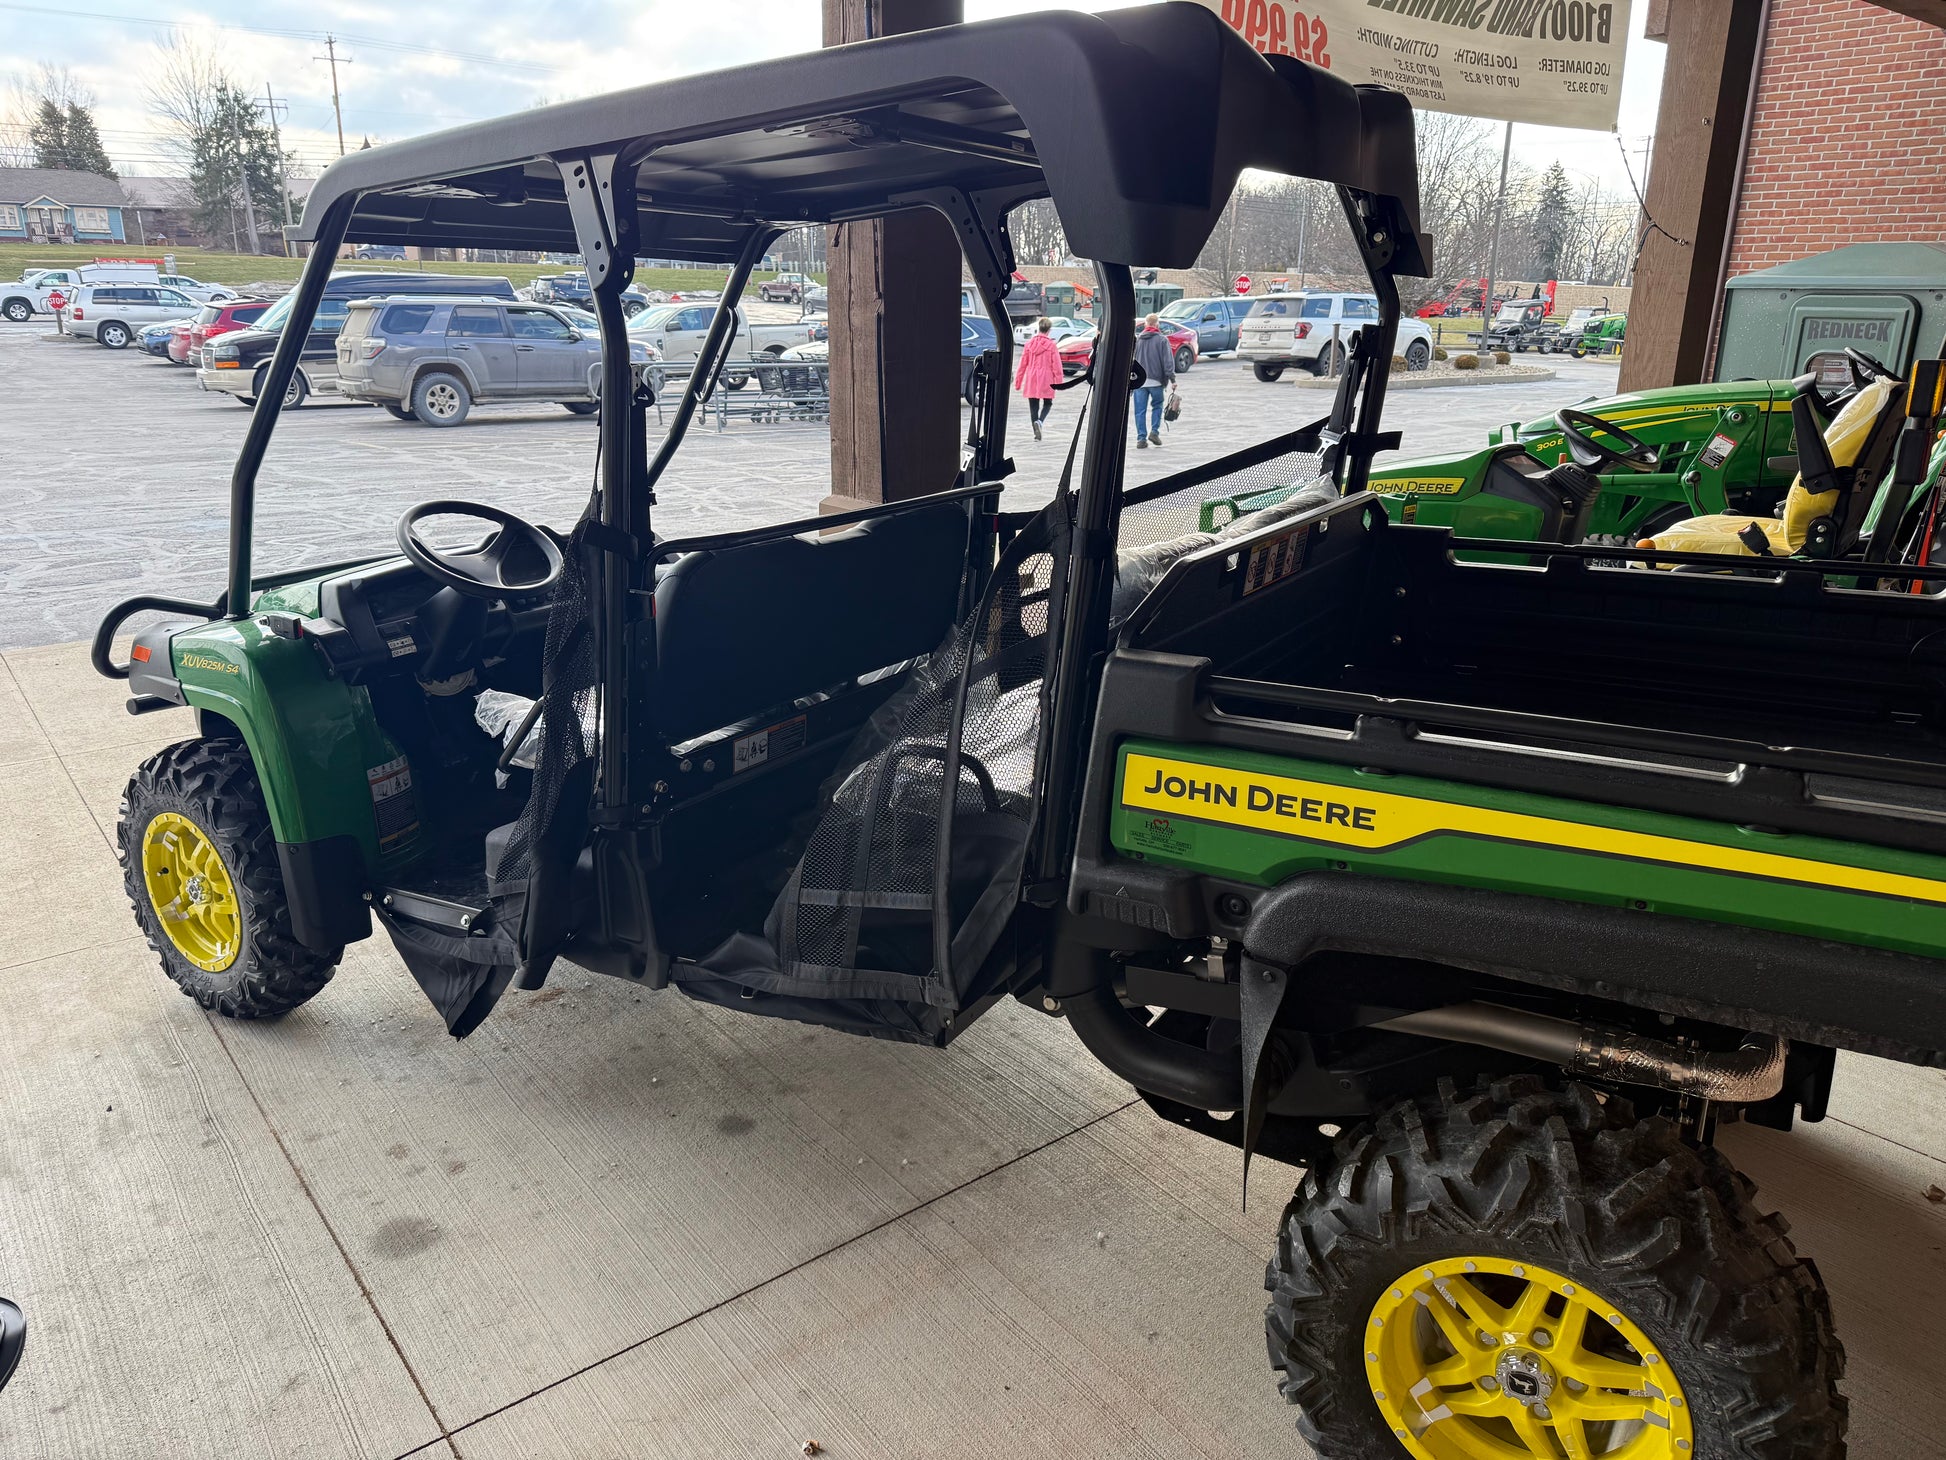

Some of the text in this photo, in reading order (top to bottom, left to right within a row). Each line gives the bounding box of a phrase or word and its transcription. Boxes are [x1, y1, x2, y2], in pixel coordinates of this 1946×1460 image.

[1235, 280, 1251, 289] STOP
[48, 297, 65, 305] STOP
[1807, 319, 1892, 342] REDNECK
[1536, 440, 1557, 452] 300
[1370, 481, 1454, 493] JOHN DEERE
[181, 653, 240, 675] XUV825M S4
[1144, 769, 1377, 832] JOHN DEERE
